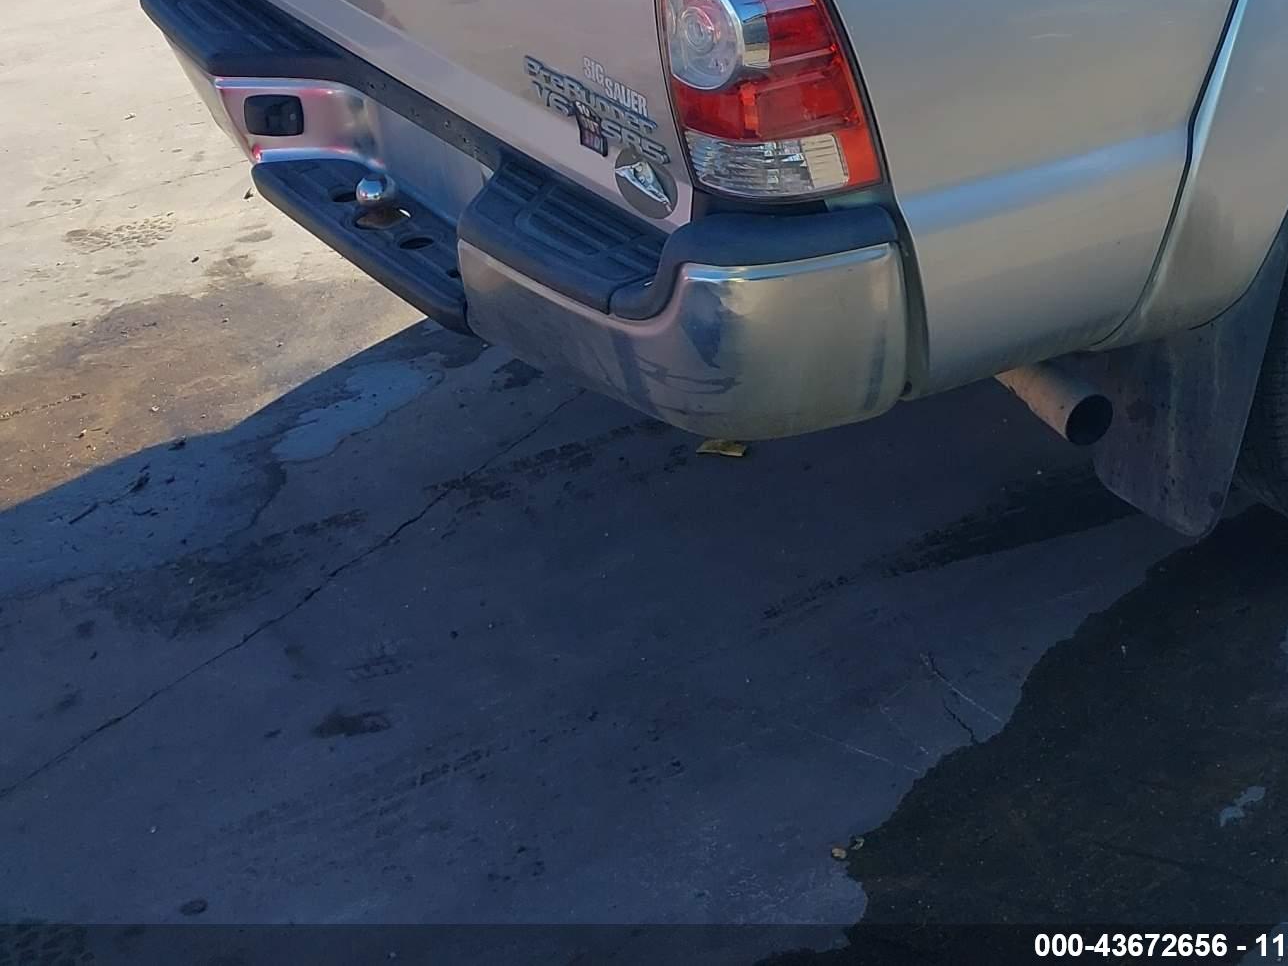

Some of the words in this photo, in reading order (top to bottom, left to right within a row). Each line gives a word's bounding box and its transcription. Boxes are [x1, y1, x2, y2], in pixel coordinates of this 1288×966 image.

[583, 56, 605, 85] SIG
[524, 55, 658, 132] PreRunner
[604, 77, 649, 118] SAUER
